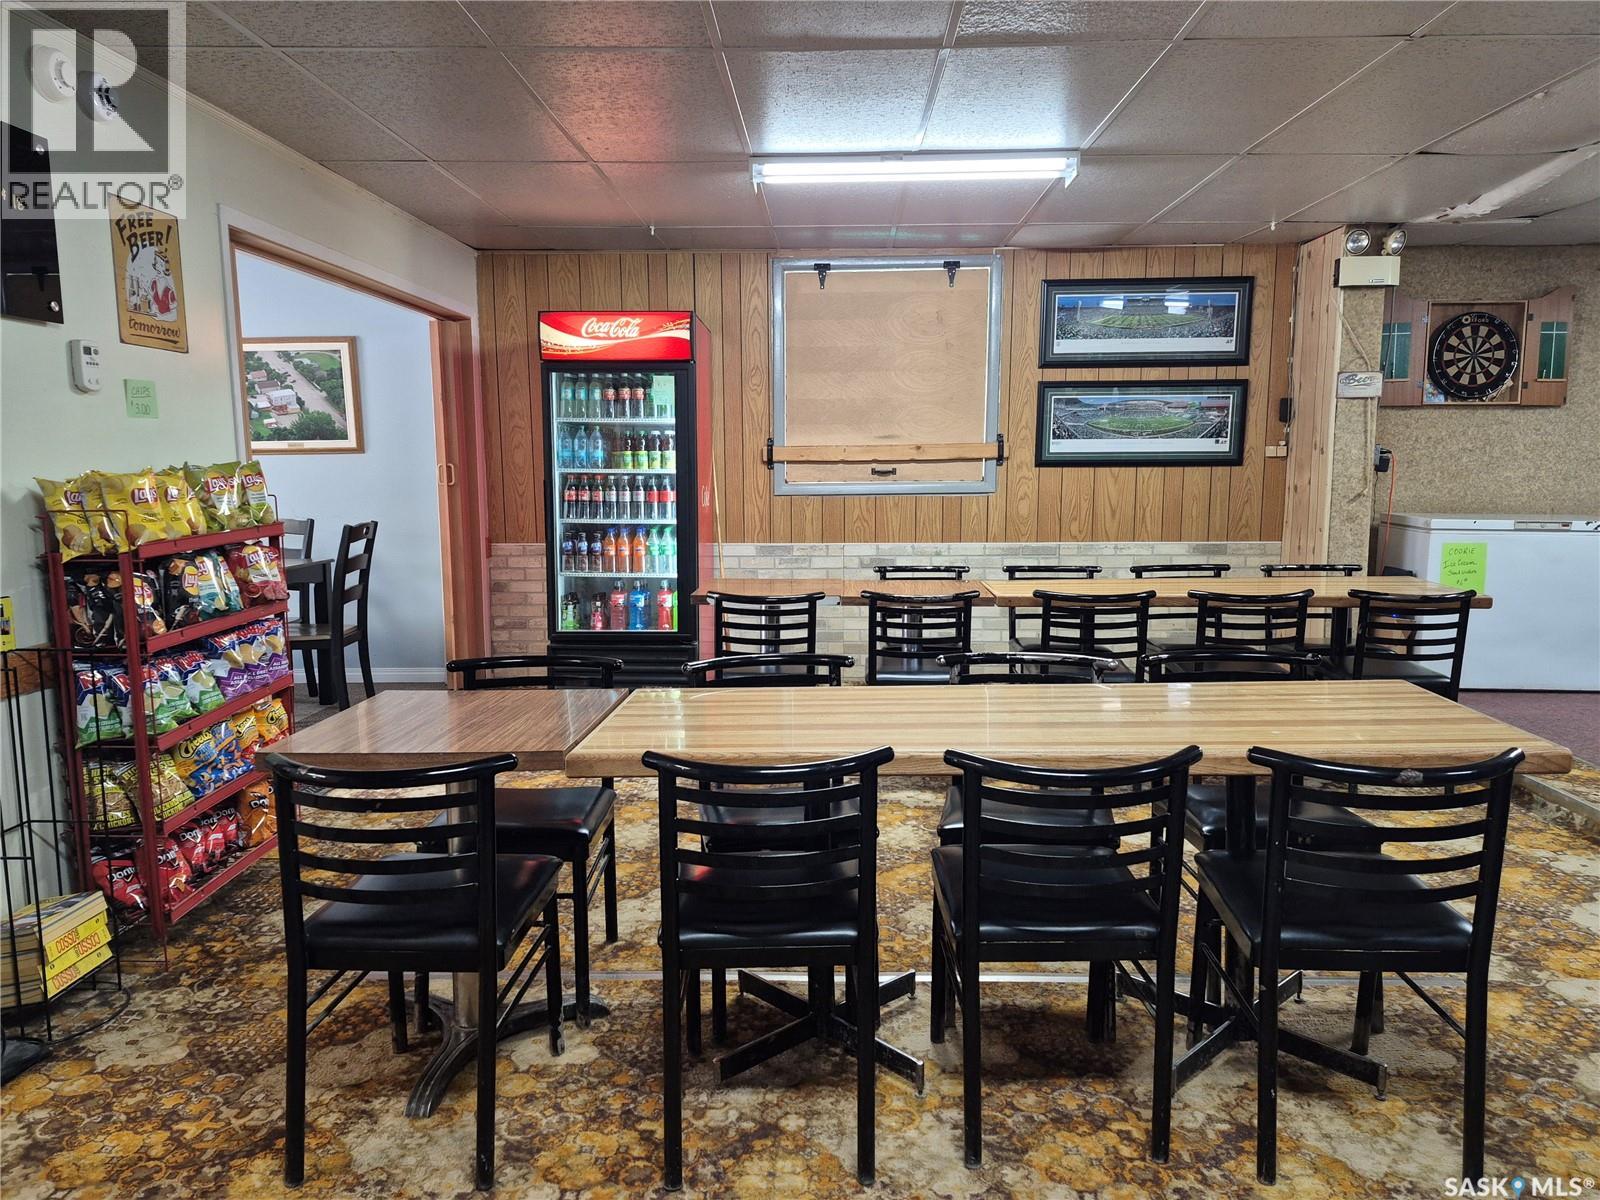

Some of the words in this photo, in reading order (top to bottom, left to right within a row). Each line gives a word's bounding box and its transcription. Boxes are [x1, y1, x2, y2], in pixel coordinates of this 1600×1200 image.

[115, 211, 153, 247] FREE
[126, 224, 172, 263] BEER!
[128, 315, 181, 338] tomorrow
[581, 316, 644, 338] Coca-Cola
[1448, 547, 1477, 555] COOKIE
